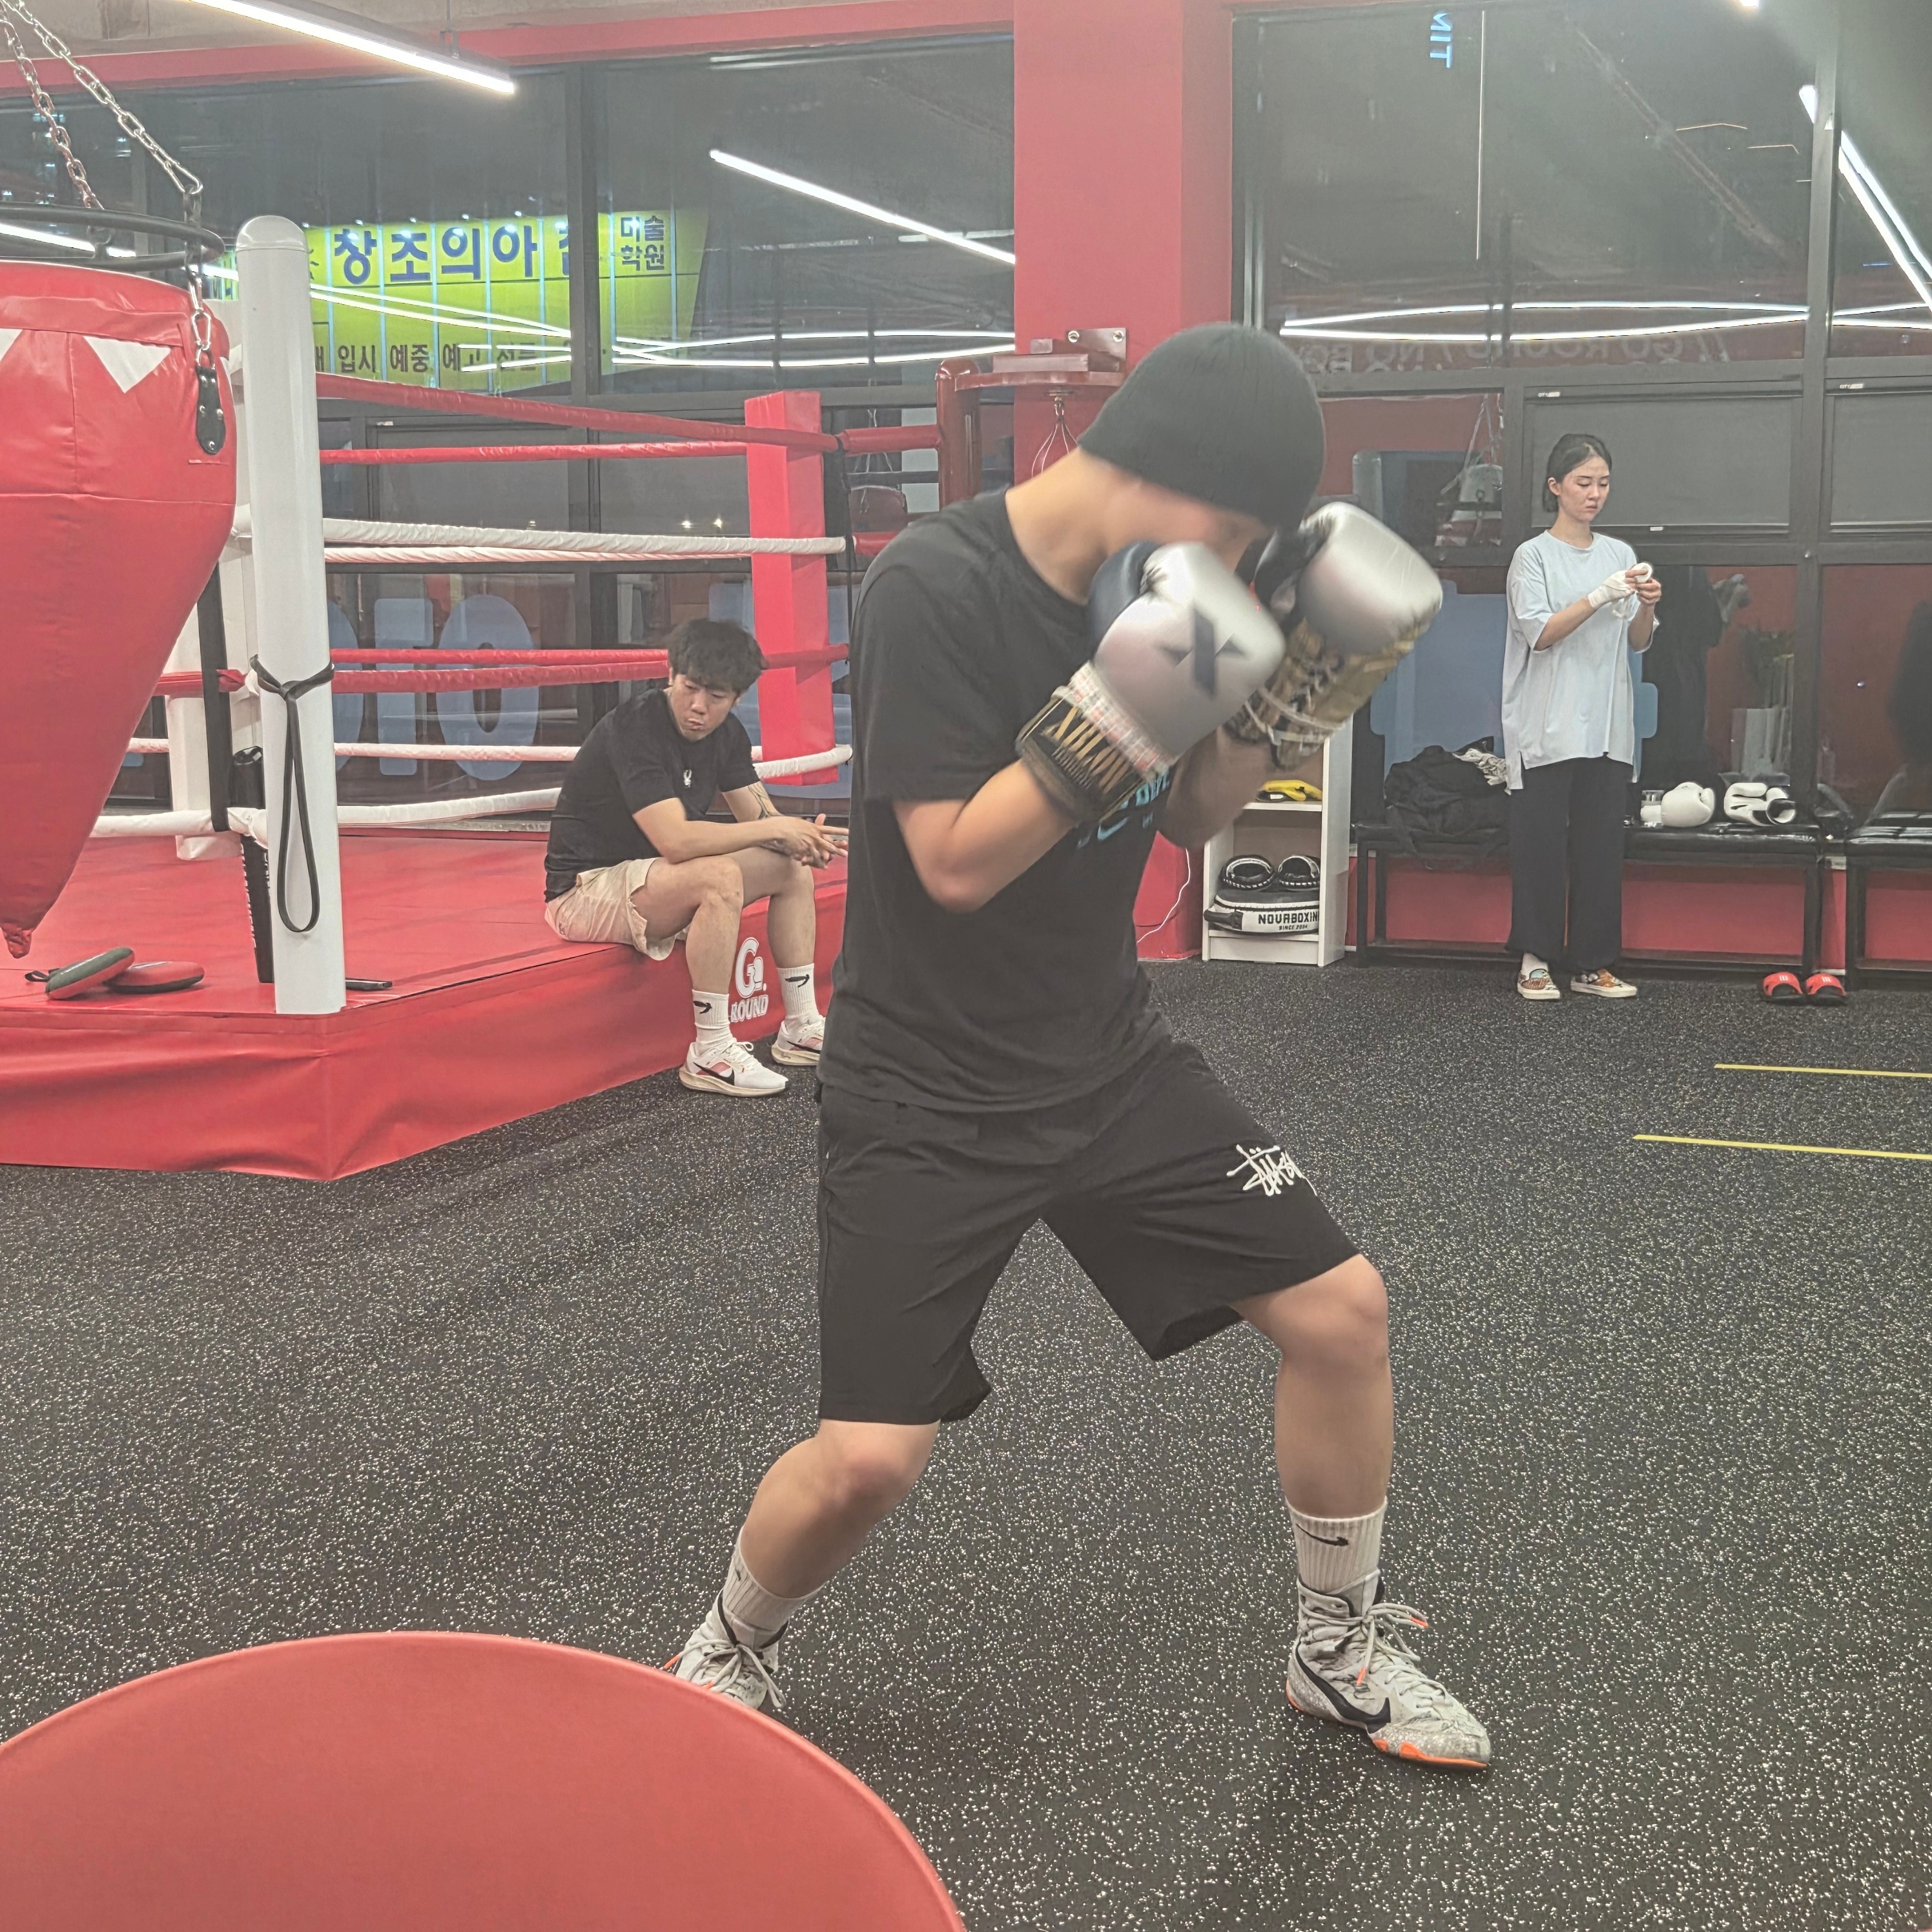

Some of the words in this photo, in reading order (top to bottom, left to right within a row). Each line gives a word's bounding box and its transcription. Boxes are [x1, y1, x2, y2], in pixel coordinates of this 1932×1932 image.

[621, 215, 664, 242] 미술
[334, 225, 570, 285] 창조의아
[621, 244, 664, 271] 학원
[338, 345, 376, 373] 입시
[390, 344, 429, 373] 예중
[730, 994, 769, 1023] ROUND
